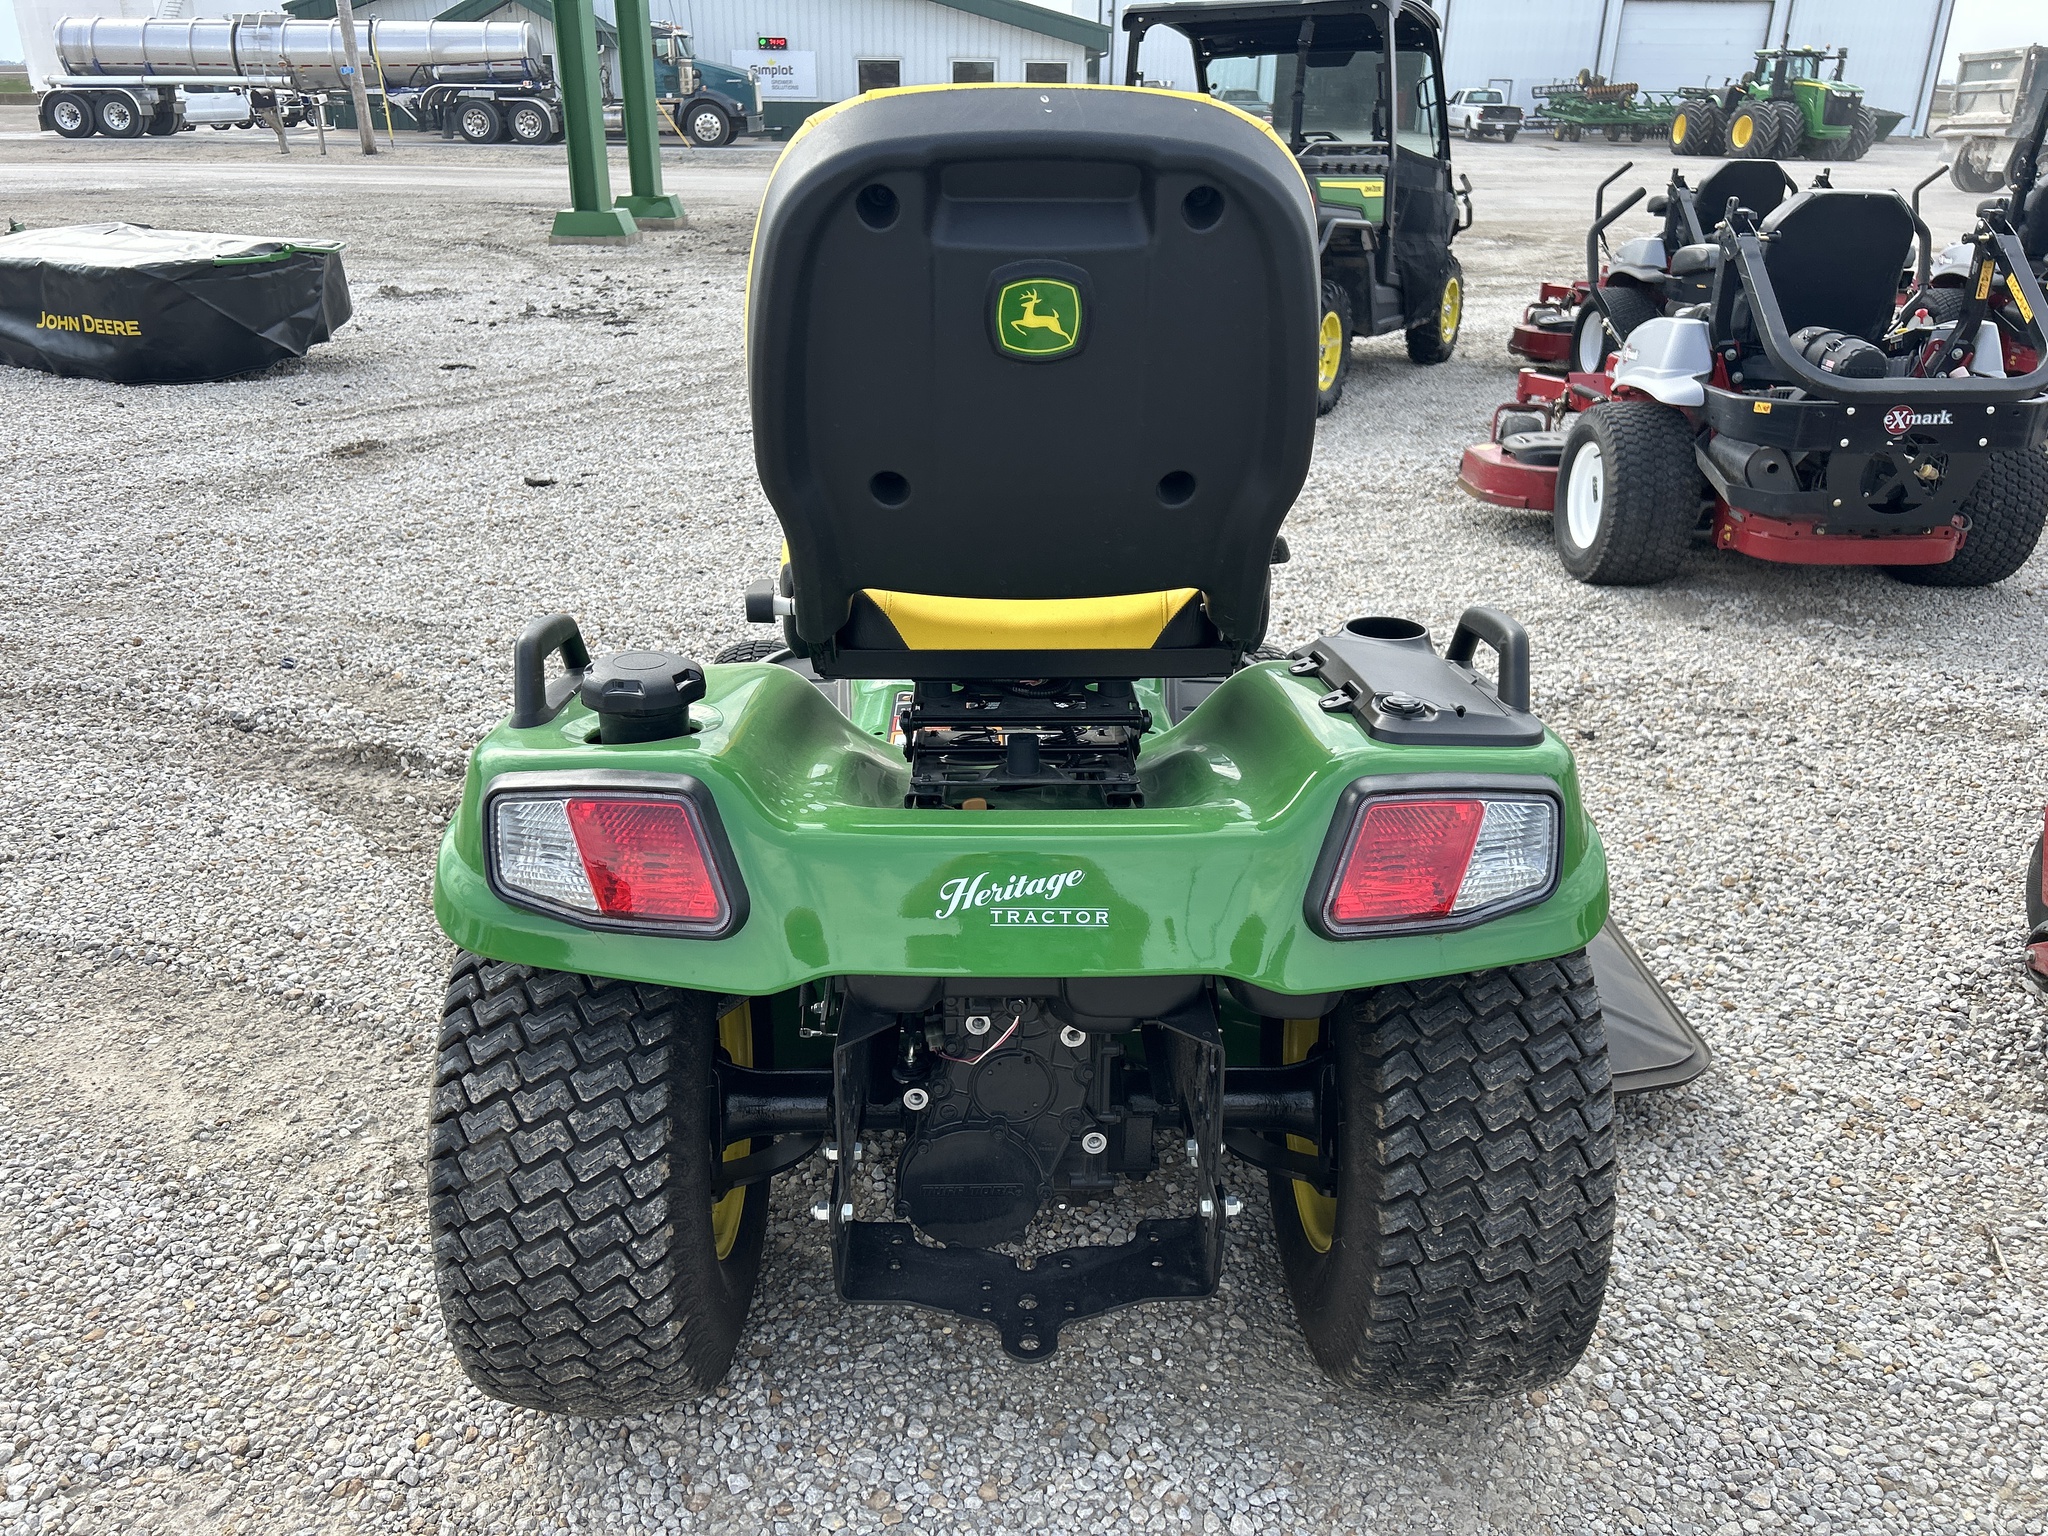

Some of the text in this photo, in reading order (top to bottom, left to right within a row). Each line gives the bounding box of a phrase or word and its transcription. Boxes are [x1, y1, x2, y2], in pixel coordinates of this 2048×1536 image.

[750, 64, 793, 78] Simplot
[36, 310, 142, 336] JOHN DEERE
[935, 868, 1086, 919] Heritage
[990, 910, 1109, 924] TRACTOR
